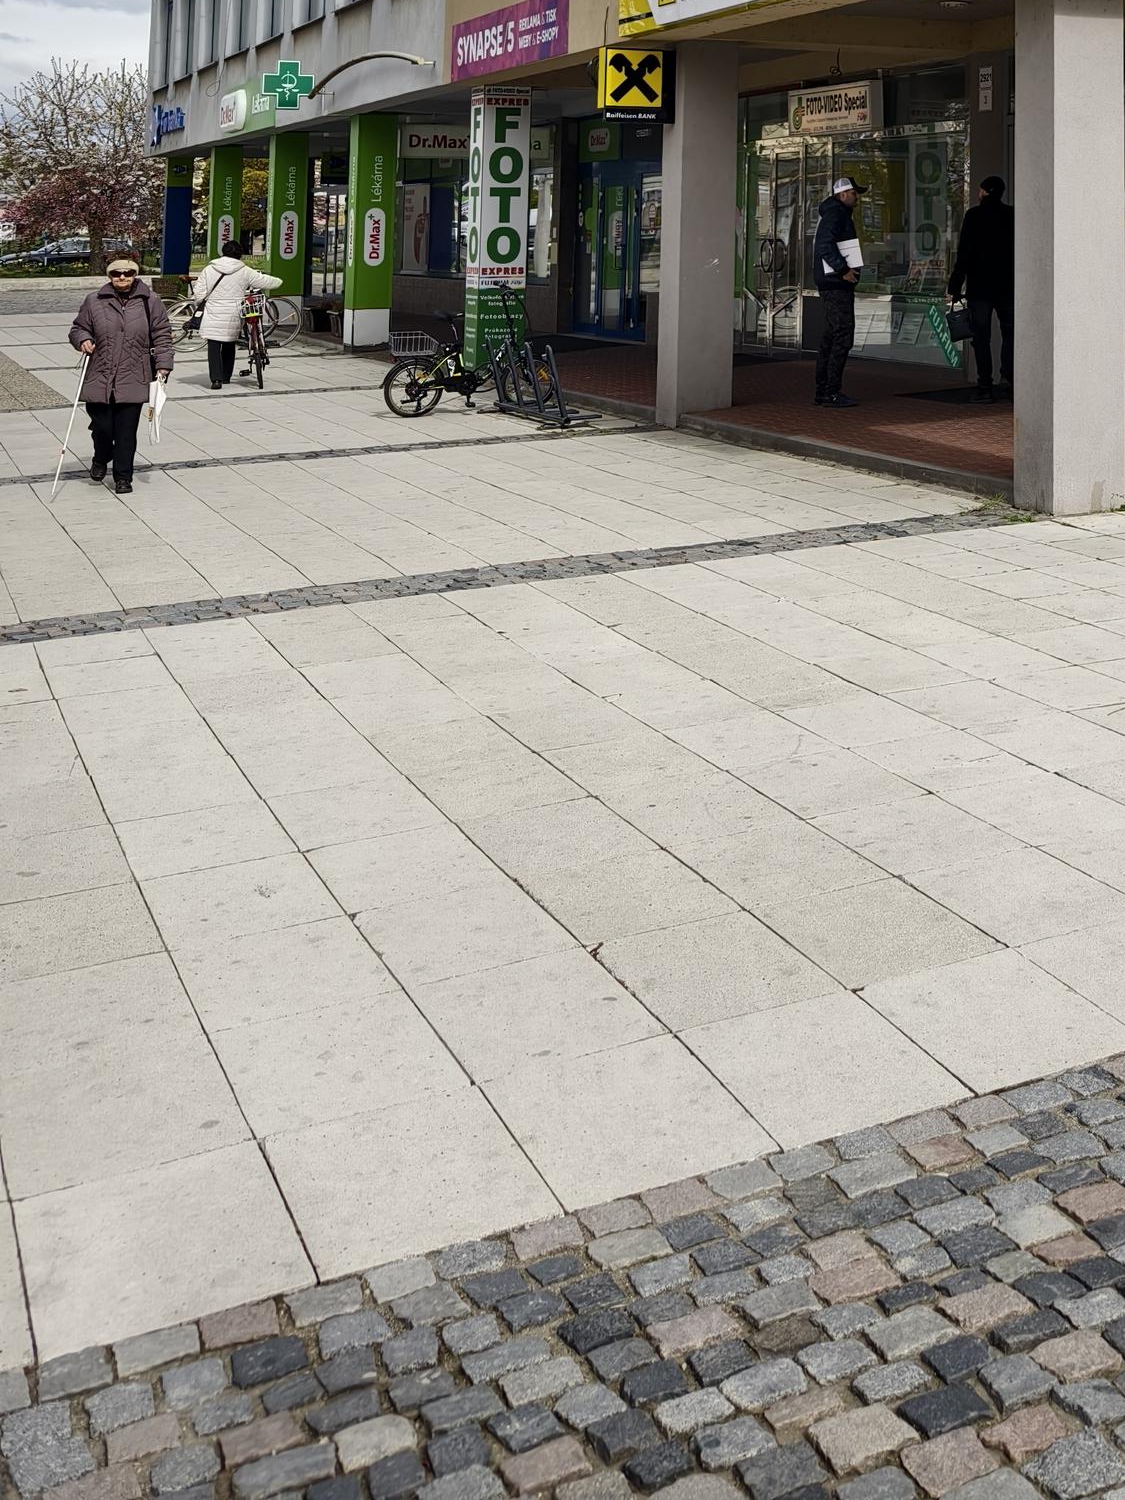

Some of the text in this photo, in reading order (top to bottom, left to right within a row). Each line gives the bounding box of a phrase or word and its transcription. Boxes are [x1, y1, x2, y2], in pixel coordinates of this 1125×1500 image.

[545, 7, 557, 23] TISK
[536, 26, 560, 45] E-SHOPY
[486, 97, 529, 106] EXPRES
[805, 90, 868, 116] FOTO-VIDEO Special
[408, 134, 468, 150] Dr.Max
[223, 176, 232, 211] Lékárna
[286, 166, 296, 206] Lékárna
[371, 155, 383, 204] Lékárna
[486, 107, 524, 265] FOTO
[284, 220, 294, 254] Dr.Max
[369, 219, 381, 260] Dr.Max
[481, 266, 525, 275] EXPRES
